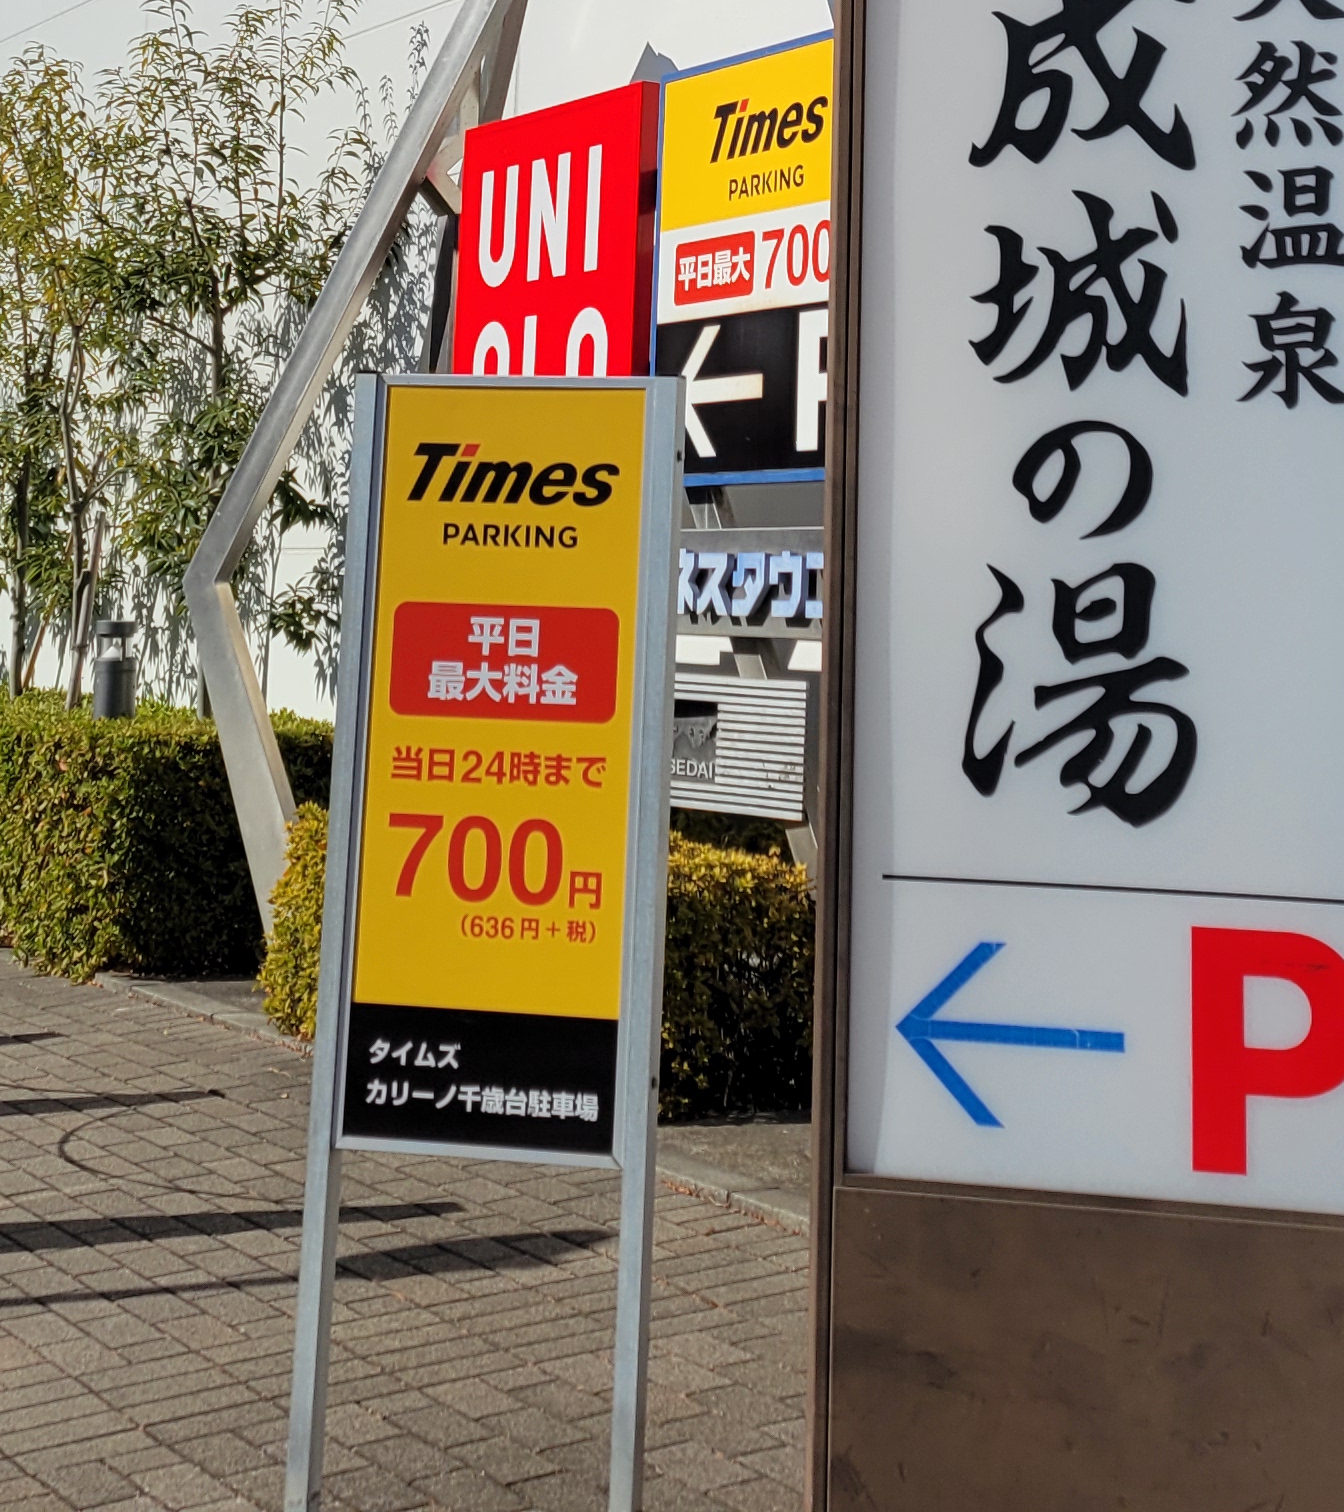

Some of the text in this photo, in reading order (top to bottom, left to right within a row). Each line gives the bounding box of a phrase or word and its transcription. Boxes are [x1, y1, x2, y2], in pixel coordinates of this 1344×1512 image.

[709, 95, 828, 164] Times
[728, 164, 805, 201] PARKING
[478, 144, 603, 288] UNI
[678, 246, 752, 293] 平日最大
[407, 443, 620, 508] Times
[442, 522, 578, 549] PARKING
[467, 615, 541, 658] 平日
[427, 660, 579, 706] 最大料金
[390, 745, 607, 789] 当日24時まで
[388, 812, 603, 910] 700円
[369, 1039, 462, 1070] タイムズ
[365, 1079, 601, 1123] カリーノ千歳台駐車場
